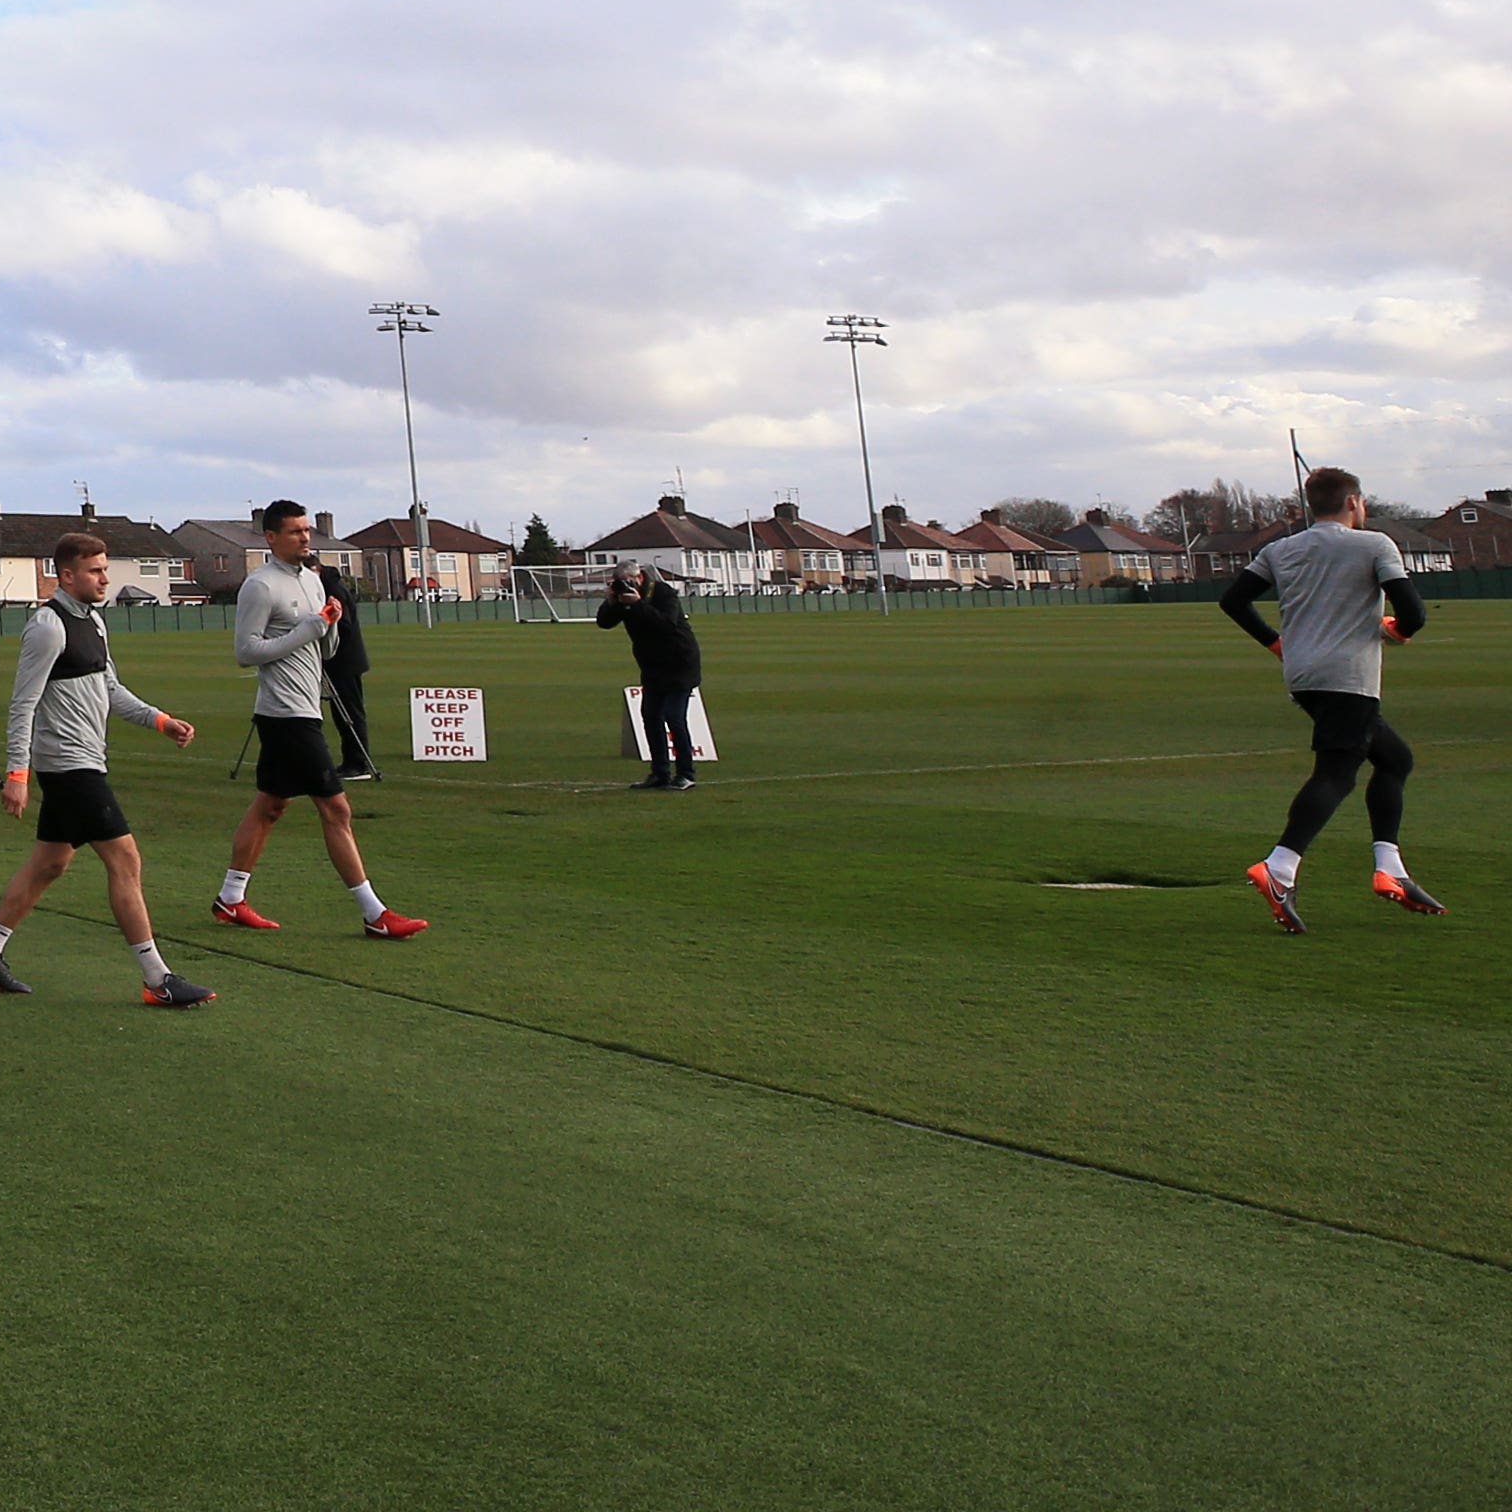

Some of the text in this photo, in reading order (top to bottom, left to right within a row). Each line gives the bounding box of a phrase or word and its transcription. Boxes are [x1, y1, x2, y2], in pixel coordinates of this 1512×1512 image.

[415, 689, 478, 700] PLEASE
[424, 703, 469, 714] KEEP
[431, 717, 465, 728] OFF
[432, 731, 465, 742] THE
[424, 745, 474, 757] PITCH
